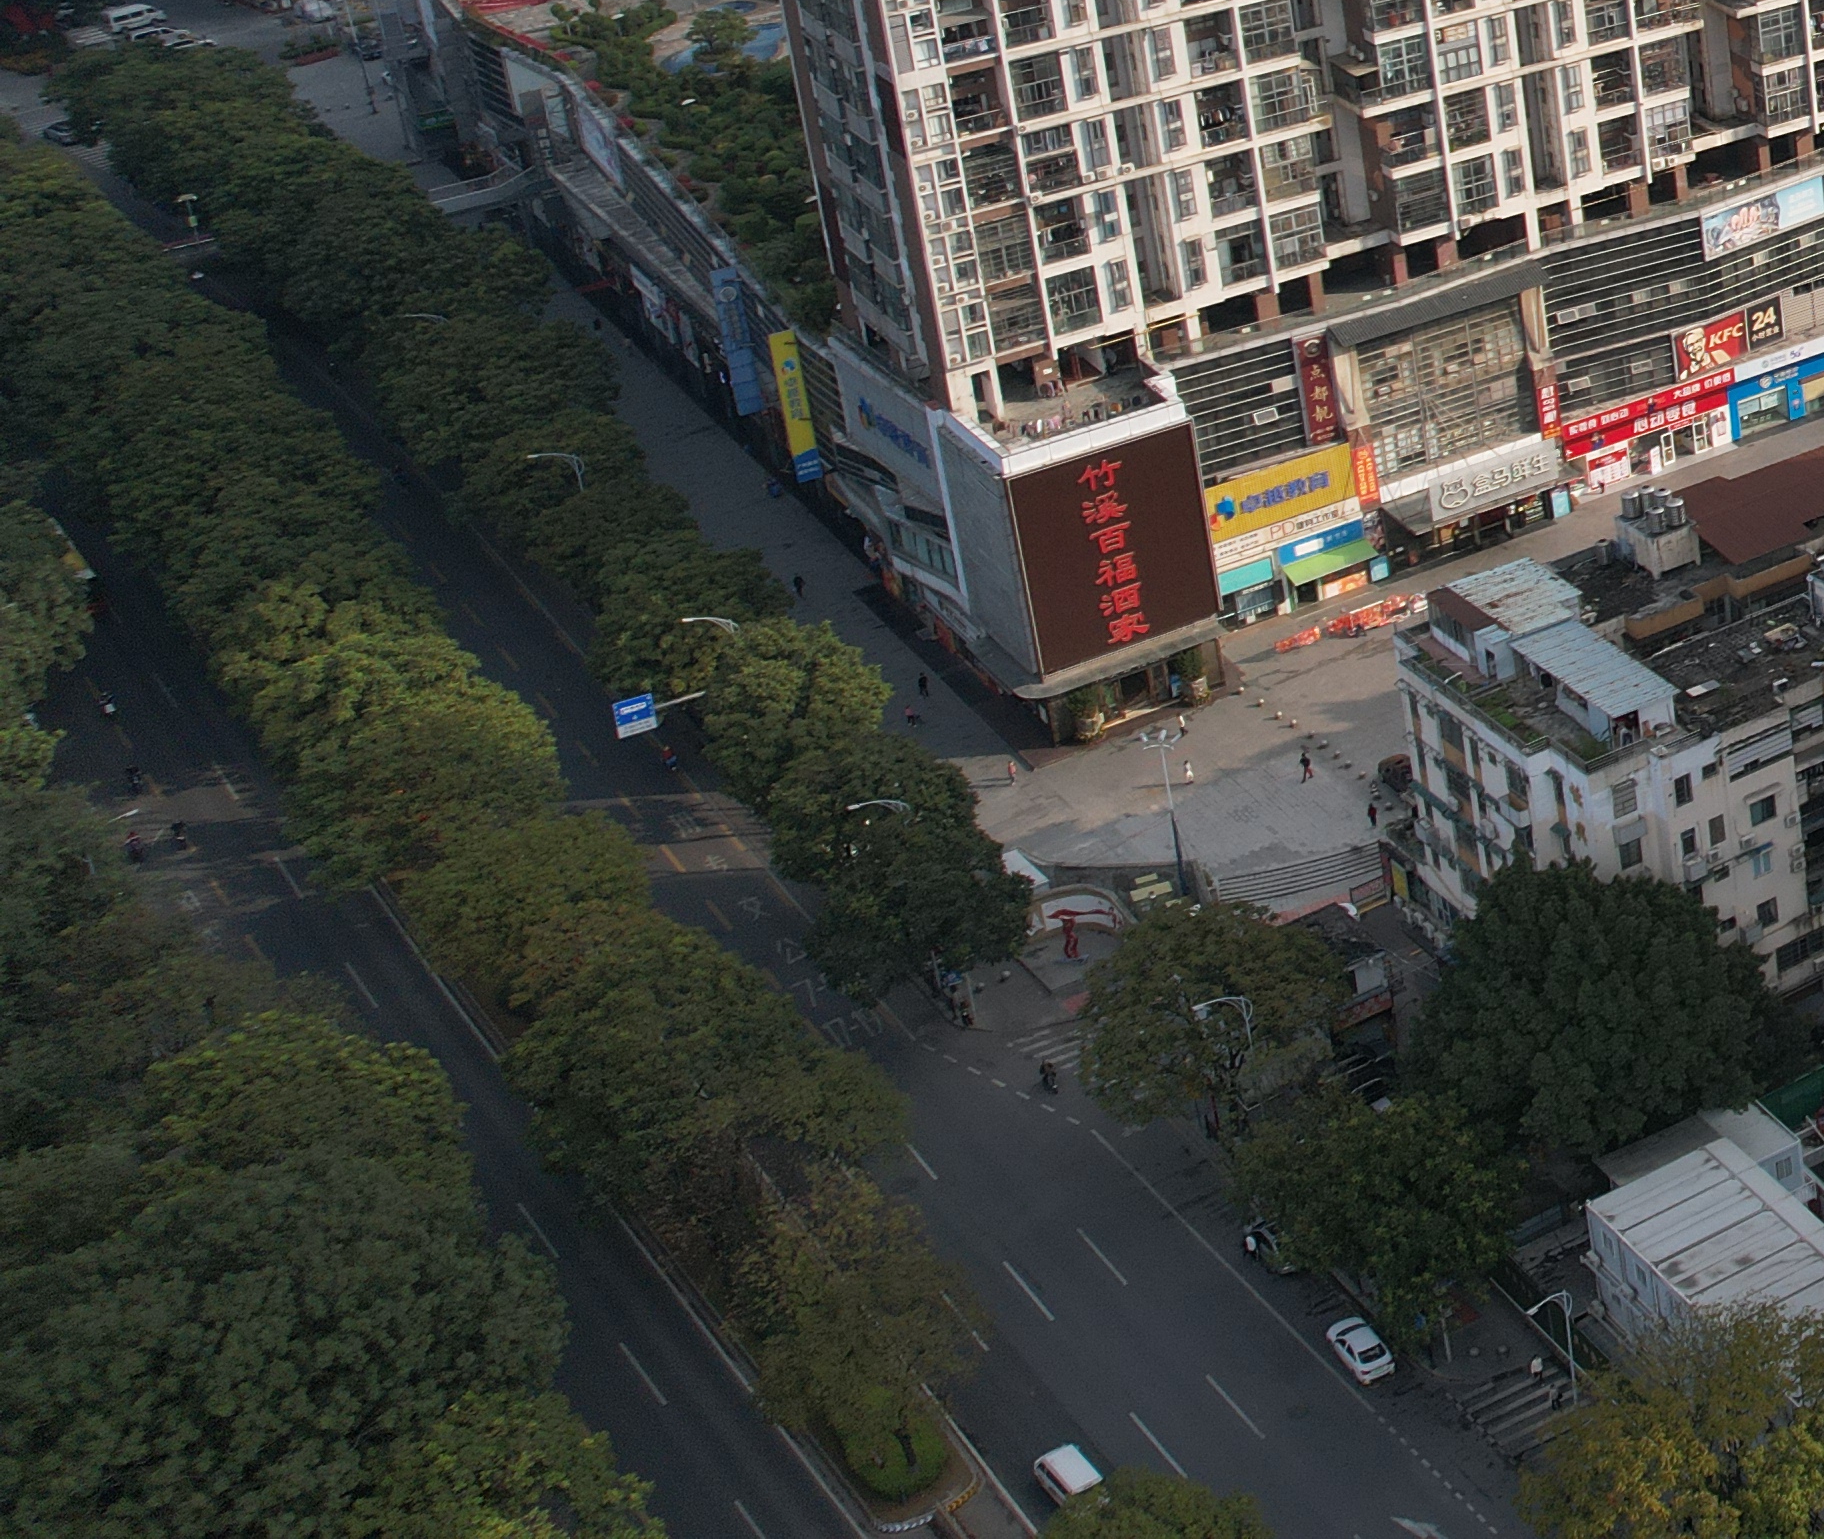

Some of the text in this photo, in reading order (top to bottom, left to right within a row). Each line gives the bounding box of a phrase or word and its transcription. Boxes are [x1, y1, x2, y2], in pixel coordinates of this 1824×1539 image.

[1752, 306, 1776, 327] 24
[1707, 321, 1745, 349] KFC
[1241, 470, 1330, 514] 卓越教育
[1472, 453, 1551, 497] 盒马鲜生
[1269, 522, 1295, 540] PD
[1077, 459, 1150, 645] 竹溪百福酒家
